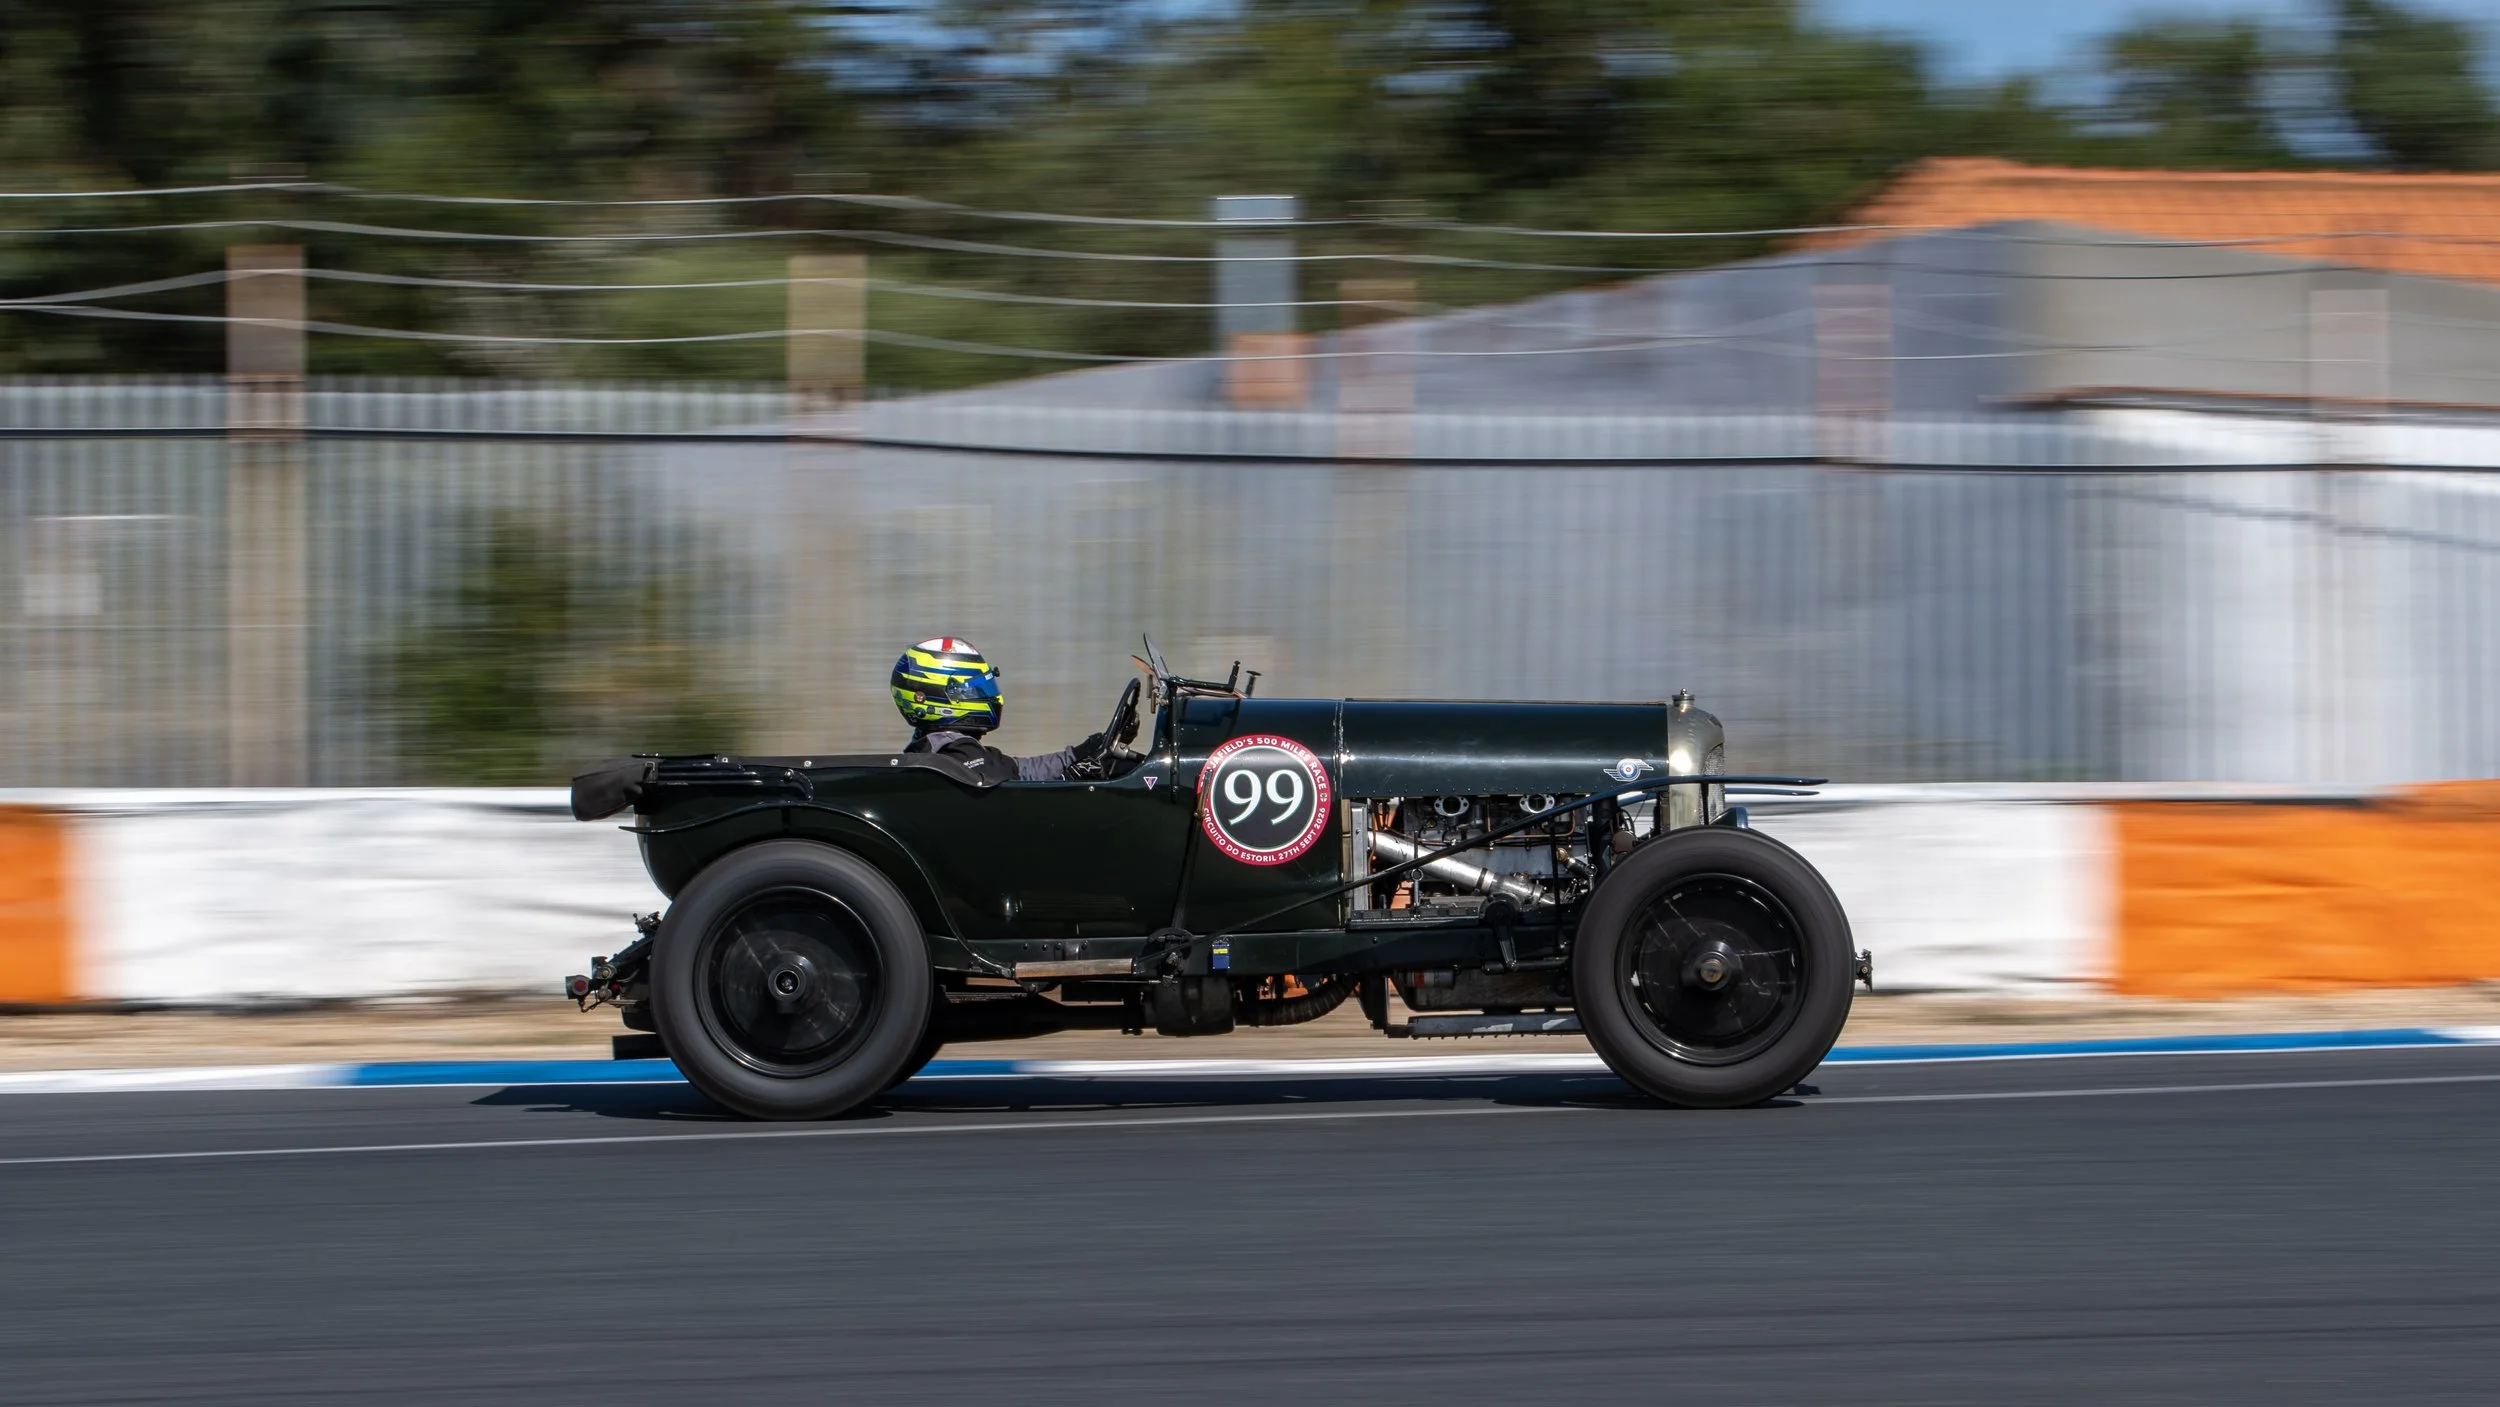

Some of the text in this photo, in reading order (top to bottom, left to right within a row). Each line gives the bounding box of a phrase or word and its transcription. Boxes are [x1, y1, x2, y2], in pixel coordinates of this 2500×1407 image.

[1201, 738, 1327, 790] JAFIELD'S 500 MILES RACE
[1224, 769, 1304, 826] 99
[1226, 844, 1239, 856] DO
[1240, 852, 1277, 862] ESTORIL
[1278, 846, 1300, 860] 27TH
[1299, 829, 1317, 849] SEPT
[1313, 807, 1326, 830] 2026
